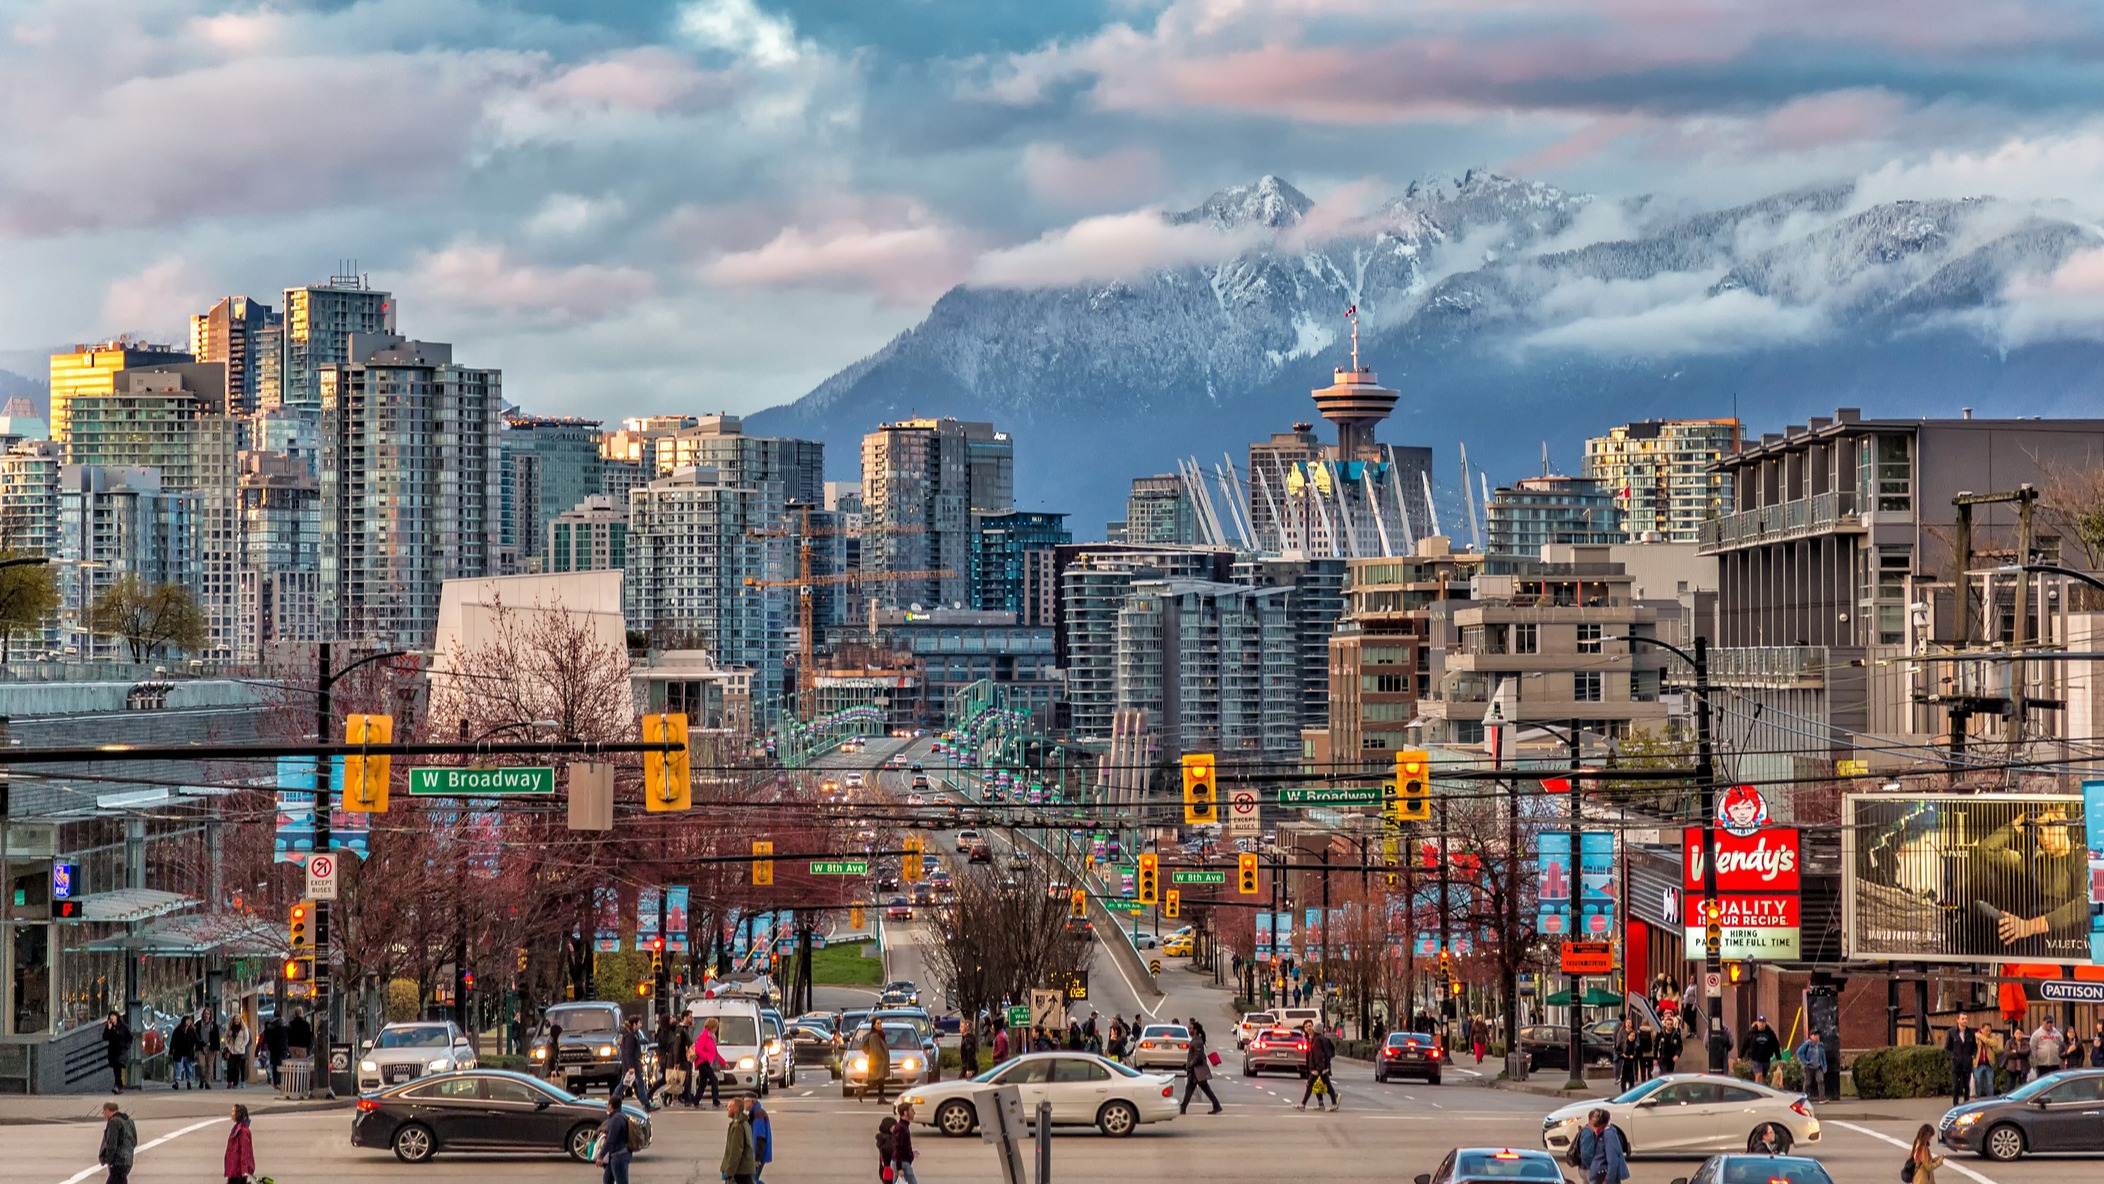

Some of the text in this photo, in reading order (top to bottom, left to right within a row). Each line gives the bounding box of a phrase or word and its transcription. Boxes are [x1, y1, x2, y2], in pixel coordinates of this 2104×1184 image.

[422, 770, 542, 791] W Broadway
[1286, 789, 1376, 804] W Broadway
[814, 864, 864, 874] W 8th Ave
[1176, 873, 1221, 882] W 8th Ave
[55, 887, 68, 895] RBC
[1719, 915, 1739, 925] UR
[1730, 930, 1758, 938] HIRING
[1725, 938, 1744, 947] TIME
[1746, 938, 1767, 947] FULL
[1771, 938, 1790, 947] TIME
[2046, 984, 2103, 999] PATTISON
